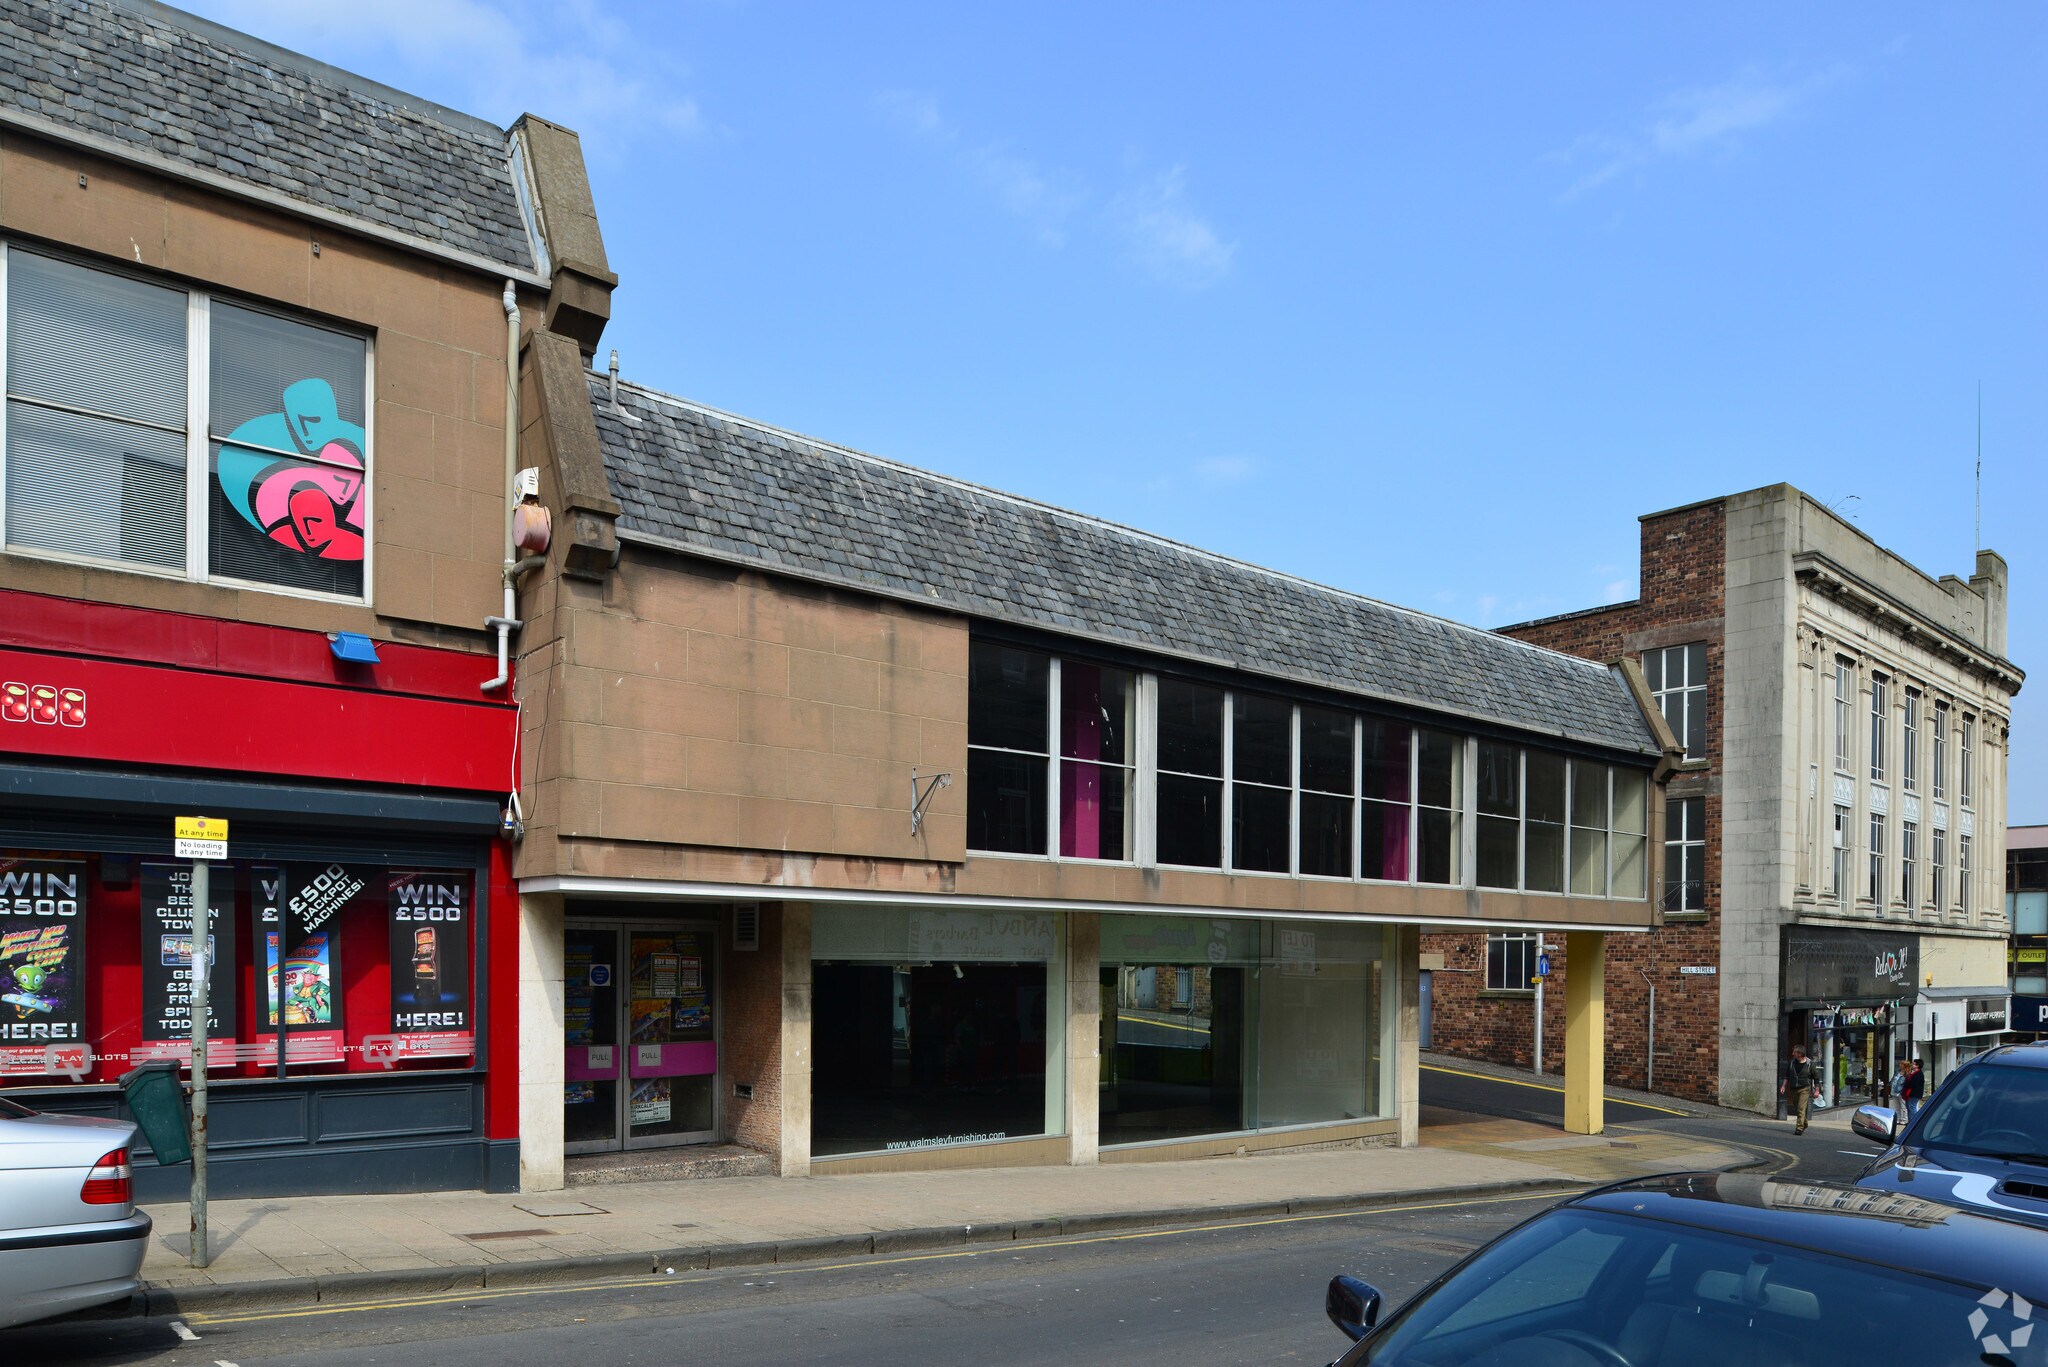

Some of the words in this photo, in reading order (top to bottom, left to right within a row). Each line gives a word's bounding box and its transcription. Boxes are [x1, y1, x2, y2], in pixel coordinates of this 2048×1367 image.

[191, 830, 205, 838] any
[194, 841, 222, 850] loading
[206, 849, 223, 857] time
[169, 872, 194, 882] JOI
[0, 871, 77, 898] WIN
[171, 884, 193, 894] TH
[289, 863, 345, 915] £500
[302, 874, 351, 922] JACKPOT
[397, 884, 460, 905] WIN
[167, 896, 193, 905] BE
[303, 878, 365, 934] MACHINES!
[395, 906, 461, 921] £500
[162, 920, 213, 930] TOW!
[172, 970, 193, 980] GE
[164, 1007, 213, 1017] SPIS
[1989, 1010, 2006, 1019] PERKINS
[159, 1019, 218, 1029] TODY!
[396, 1012, 463, 1027] HERE!
[53, 1054, 84, 1063] PLAY
[88, 1053, 129, 1061] SLOTS
[886, 1131, 1006, 1150] www.walmsleyfurnishing.com
